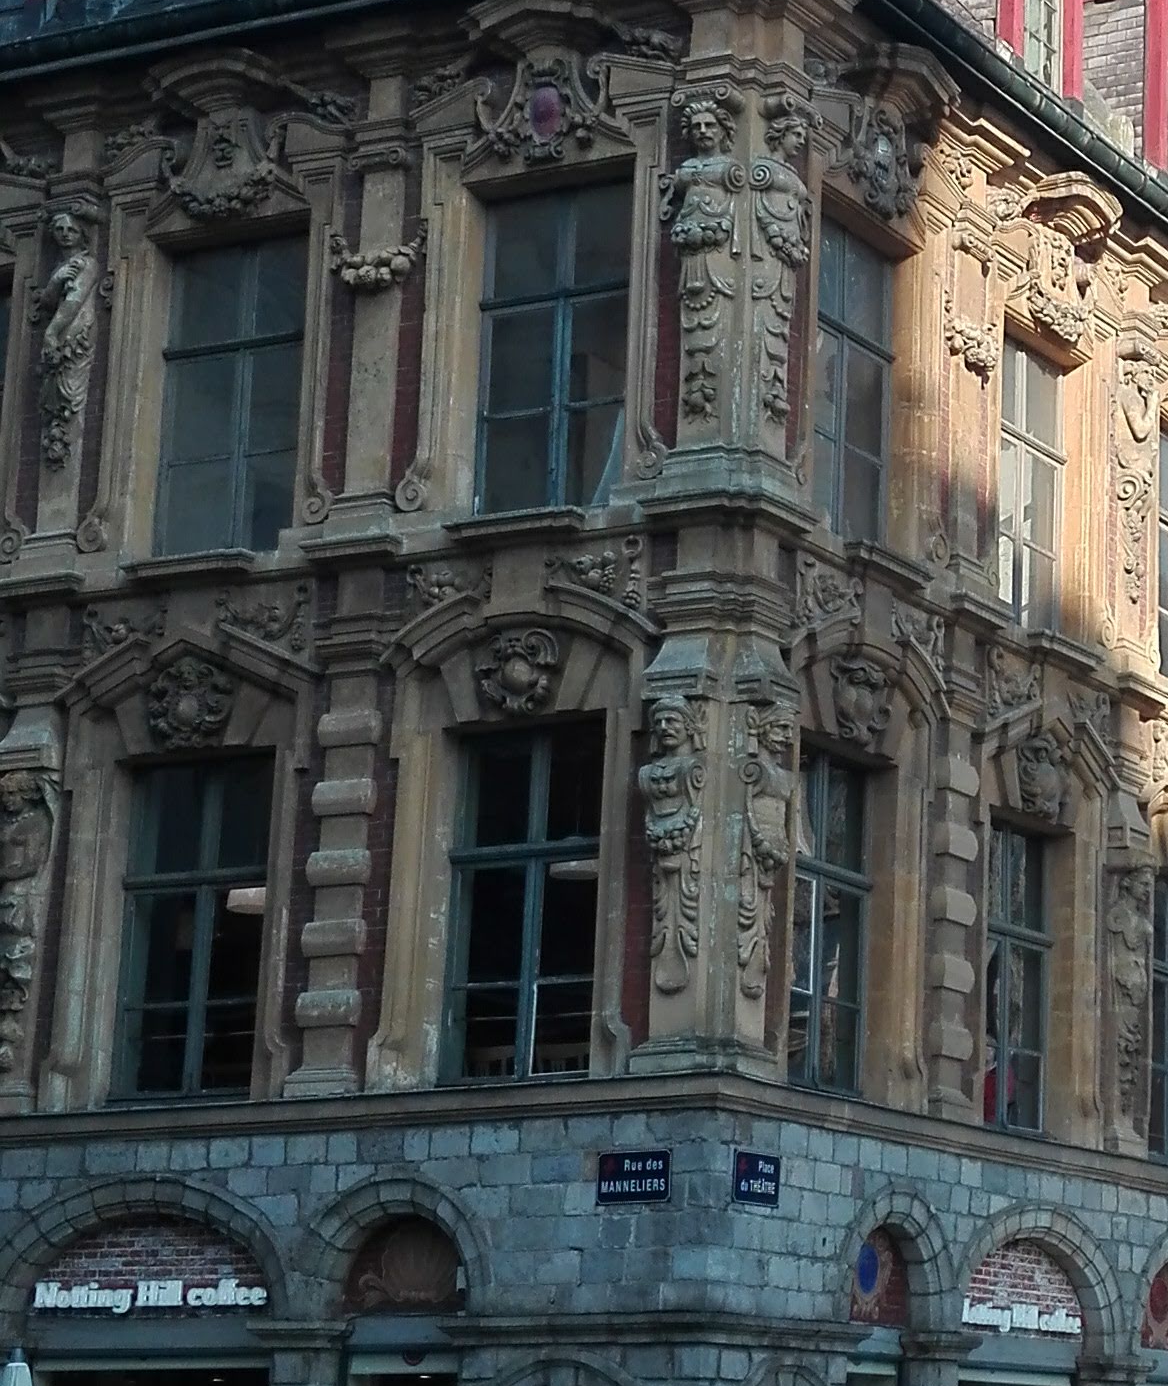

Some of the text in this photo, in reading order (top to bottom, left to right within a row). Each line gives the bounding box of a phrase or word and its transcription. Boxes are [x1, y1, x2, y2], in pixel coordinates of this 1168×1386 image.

[624, 1158, 663, 1171] Rue des
[758, 1160, 775, 1174] Place
[600, 1178, 666, 1193] MANNELIERS
[740, 1178, 776, 1195] du THÉÂTRE
[33, 1278, 268, 1314] Notting Hill coffee
